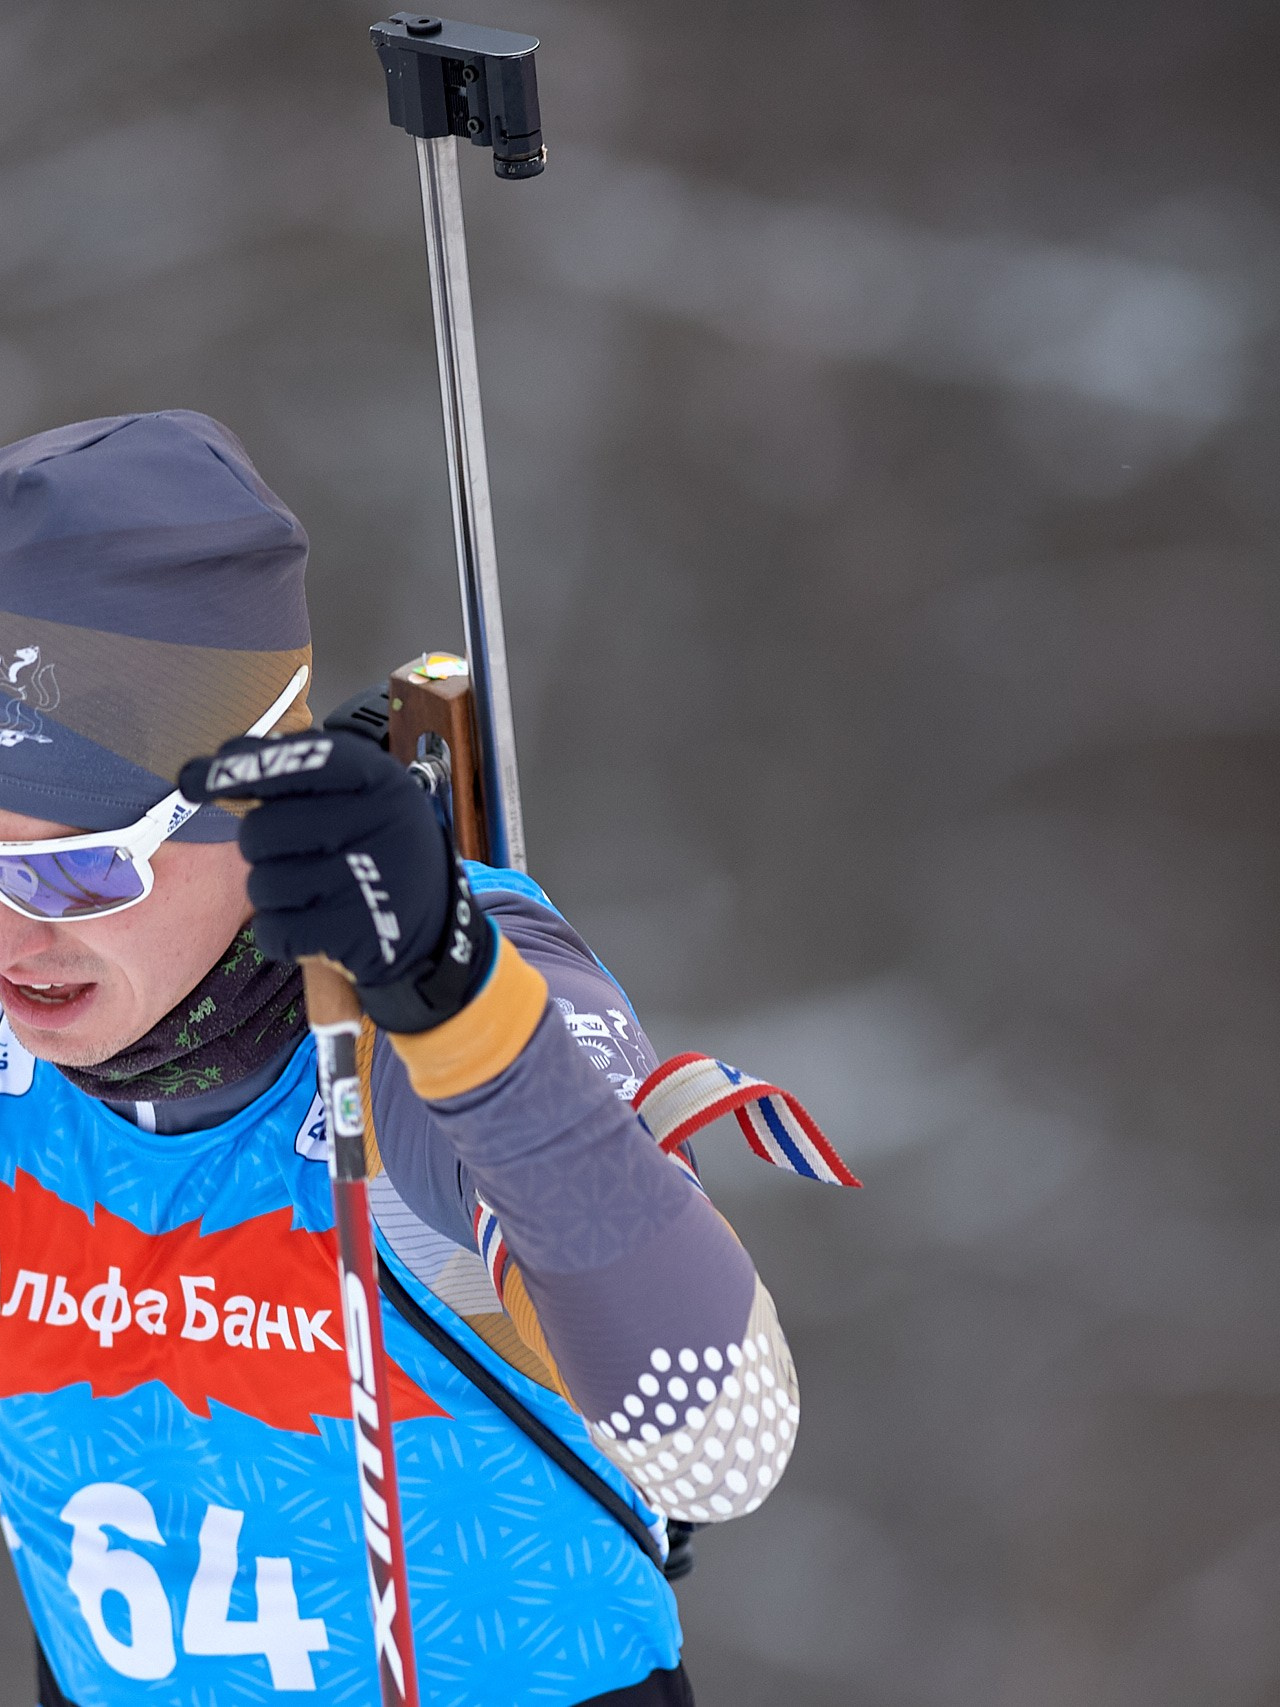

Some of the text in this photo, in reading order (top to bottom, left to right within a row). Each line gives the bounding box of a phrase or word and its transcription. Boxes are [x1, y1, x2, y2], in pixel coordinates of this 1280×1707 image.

[166, 809, 193, 833] adidas
[179, 1274, 345, 1353] Банк
[60, 1481, 330, 1692] 64
